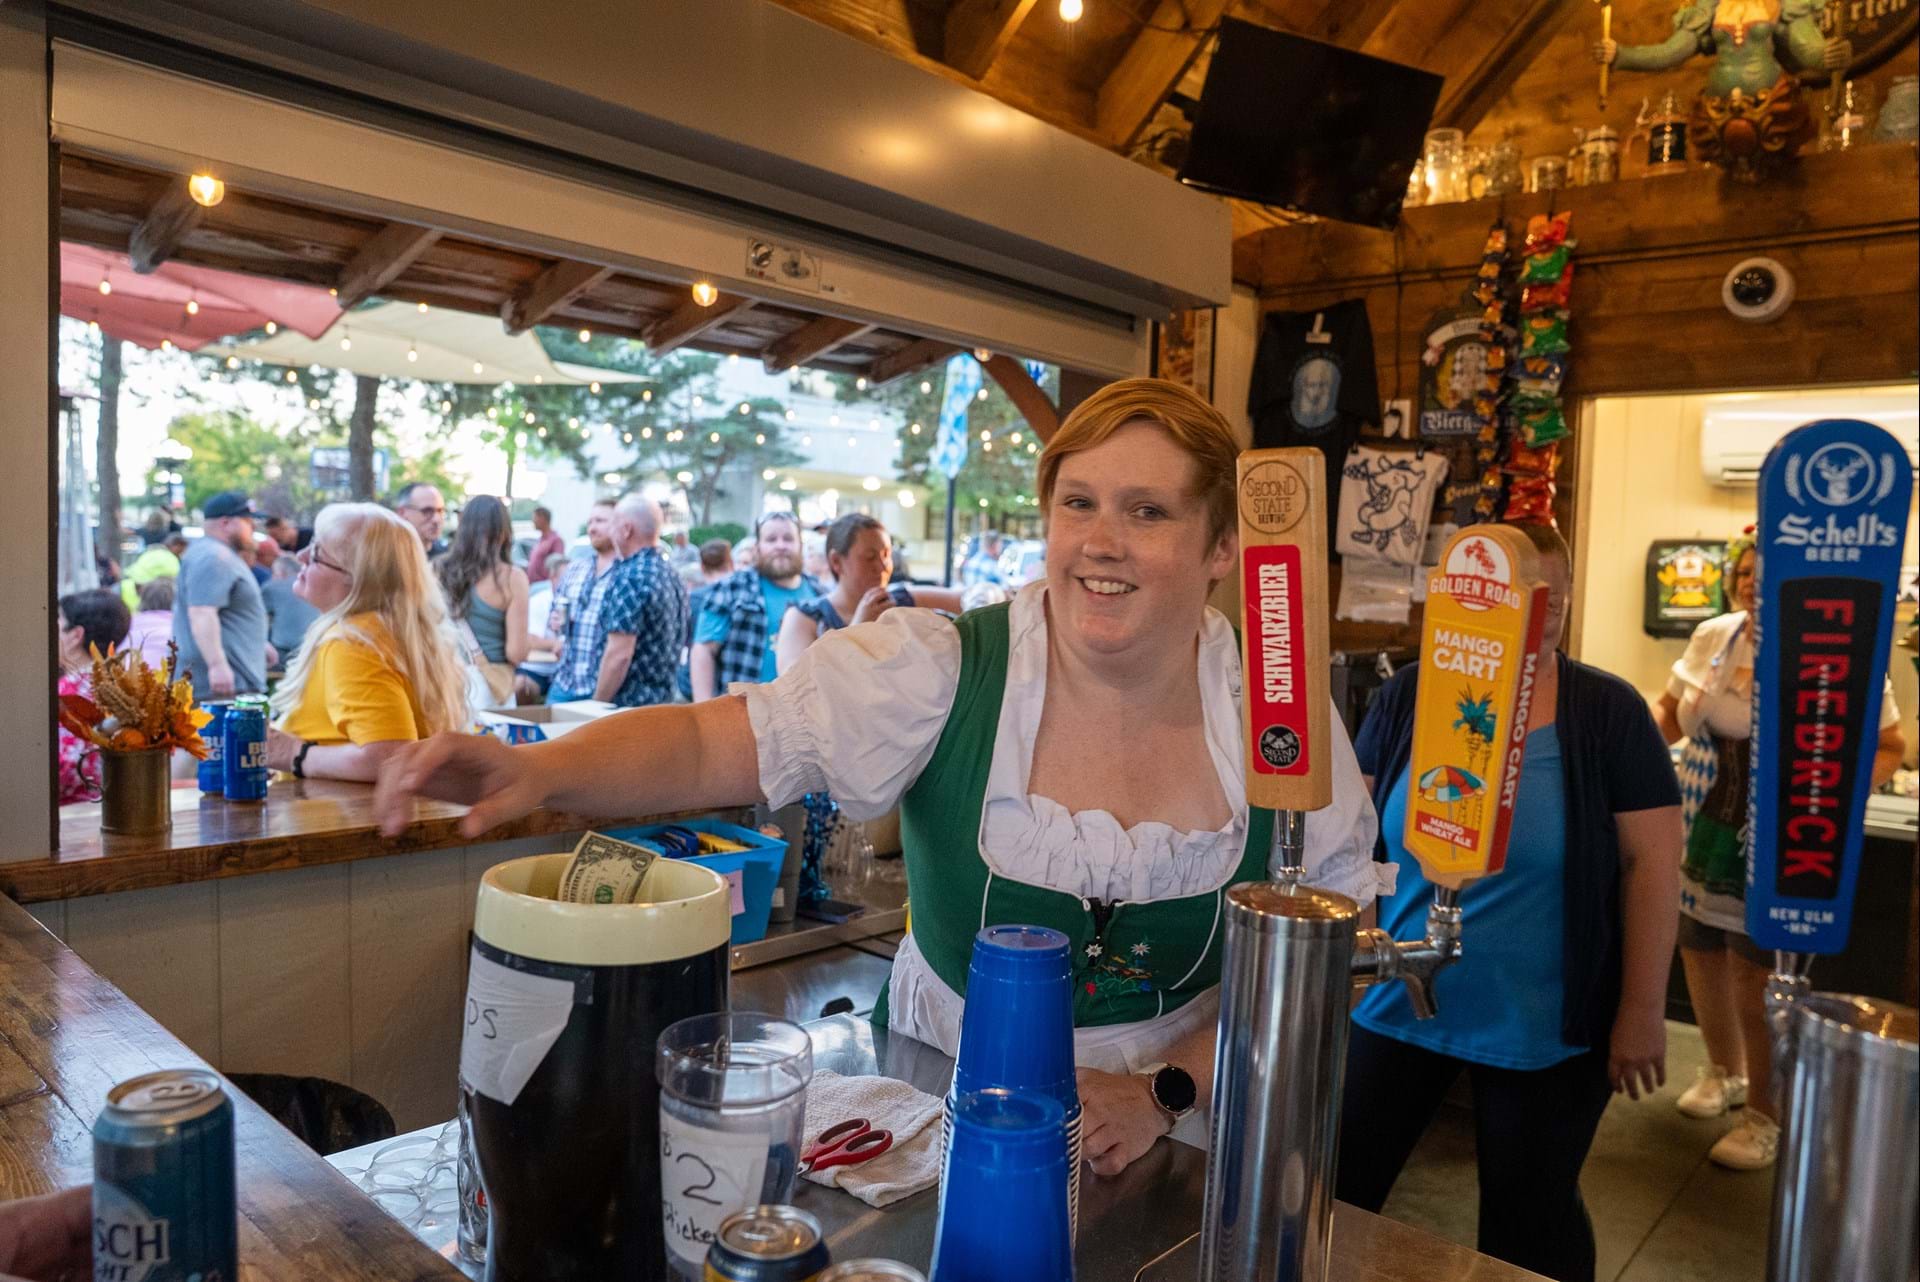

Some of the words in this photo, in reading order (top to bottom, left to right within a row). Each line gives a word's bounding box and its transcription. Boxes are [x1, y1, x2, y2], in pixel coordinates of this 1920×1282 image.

[1246, 475, 1298, 497] SECOND
[1253, 496, 1291, 514] STATE
[1773, 512, 1897, 547] Schell's
[1804, 546, 1861, 562] BEER
[1430, 577, 1482, 597] GOLDEN
[1484, 581, 1521, 609] ROAD
[1259, 562, 1294, 704] SCHWARZBIER
[1434, 628, 1505, 658] MANGO
[1433, 647, 1503, 682] CART
[1512, 652, 1537, 742] MANGO
[1264, 747, 1297, 758] SECOND
[1784, 598, 1854, 878] FIREBRICK
[1268, 754, 1292, 763] STATE
[1501, 747, 1521, 809] CART
[1421, 821, 1454, 841] WHEAT
[1453, 834, 1473, 848] ALE
[1430, 816, 1465, 836] MANGO
[1769, 906, 1800, 922] NEW
[1803, 908, 1835, 925] ULM
[466, 997, 499, 1040] PS
[94, 1216, 166, 1263] SCH
